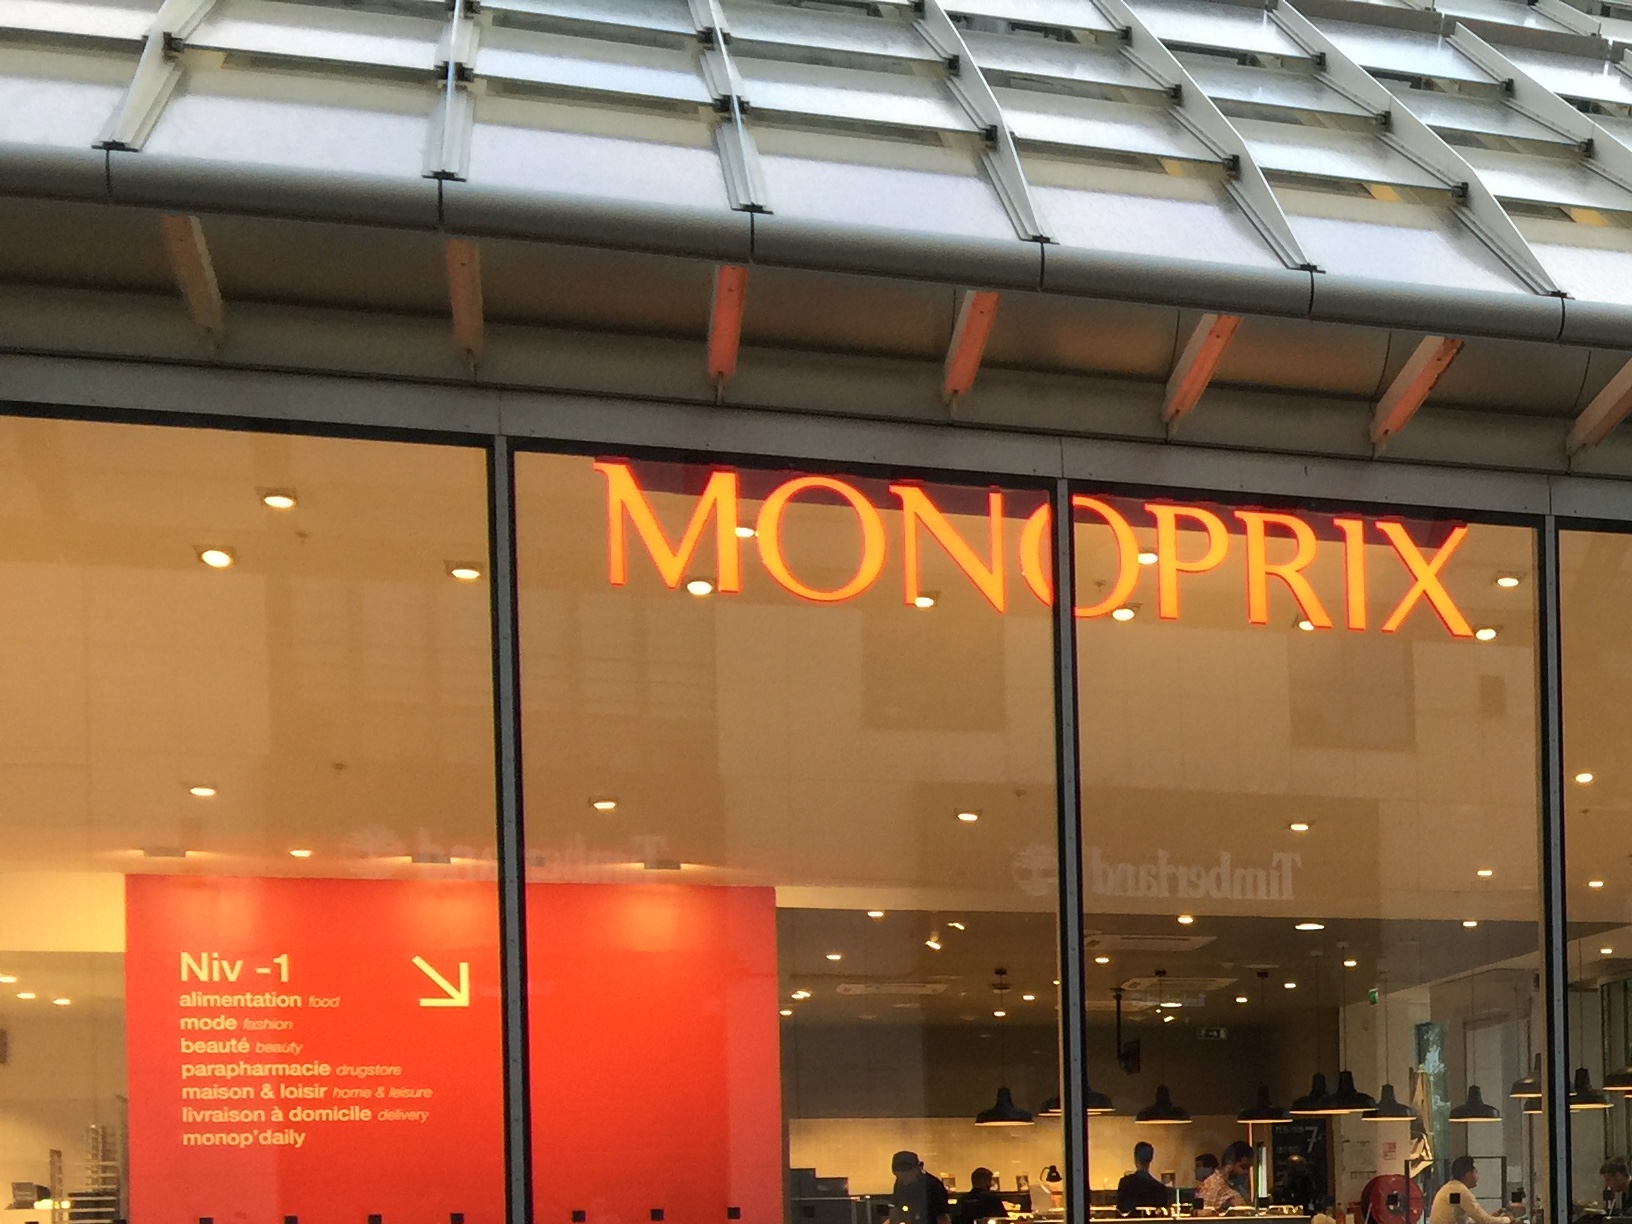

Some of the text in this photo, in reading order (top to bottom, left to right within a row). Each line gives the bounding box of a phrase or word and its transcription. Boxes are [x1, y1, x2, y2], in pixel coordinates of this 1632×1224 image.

[593, 457, 1473, 639] MONOPRIX
[180, 951, 290, 983] Niv -1
[178, 990, 341, 1008] alimentation food
[179, 1014, 294, 1031] mode fashion
[180, 1036, 304, 1056] beauté beauty
[181, 1059, 403, 1080] parapharmacie drugstore
[181, 1082, 434, 1100] maison & loisir home & leisure
[181, 1105, 430, 1124] livraison à domicile delivery
